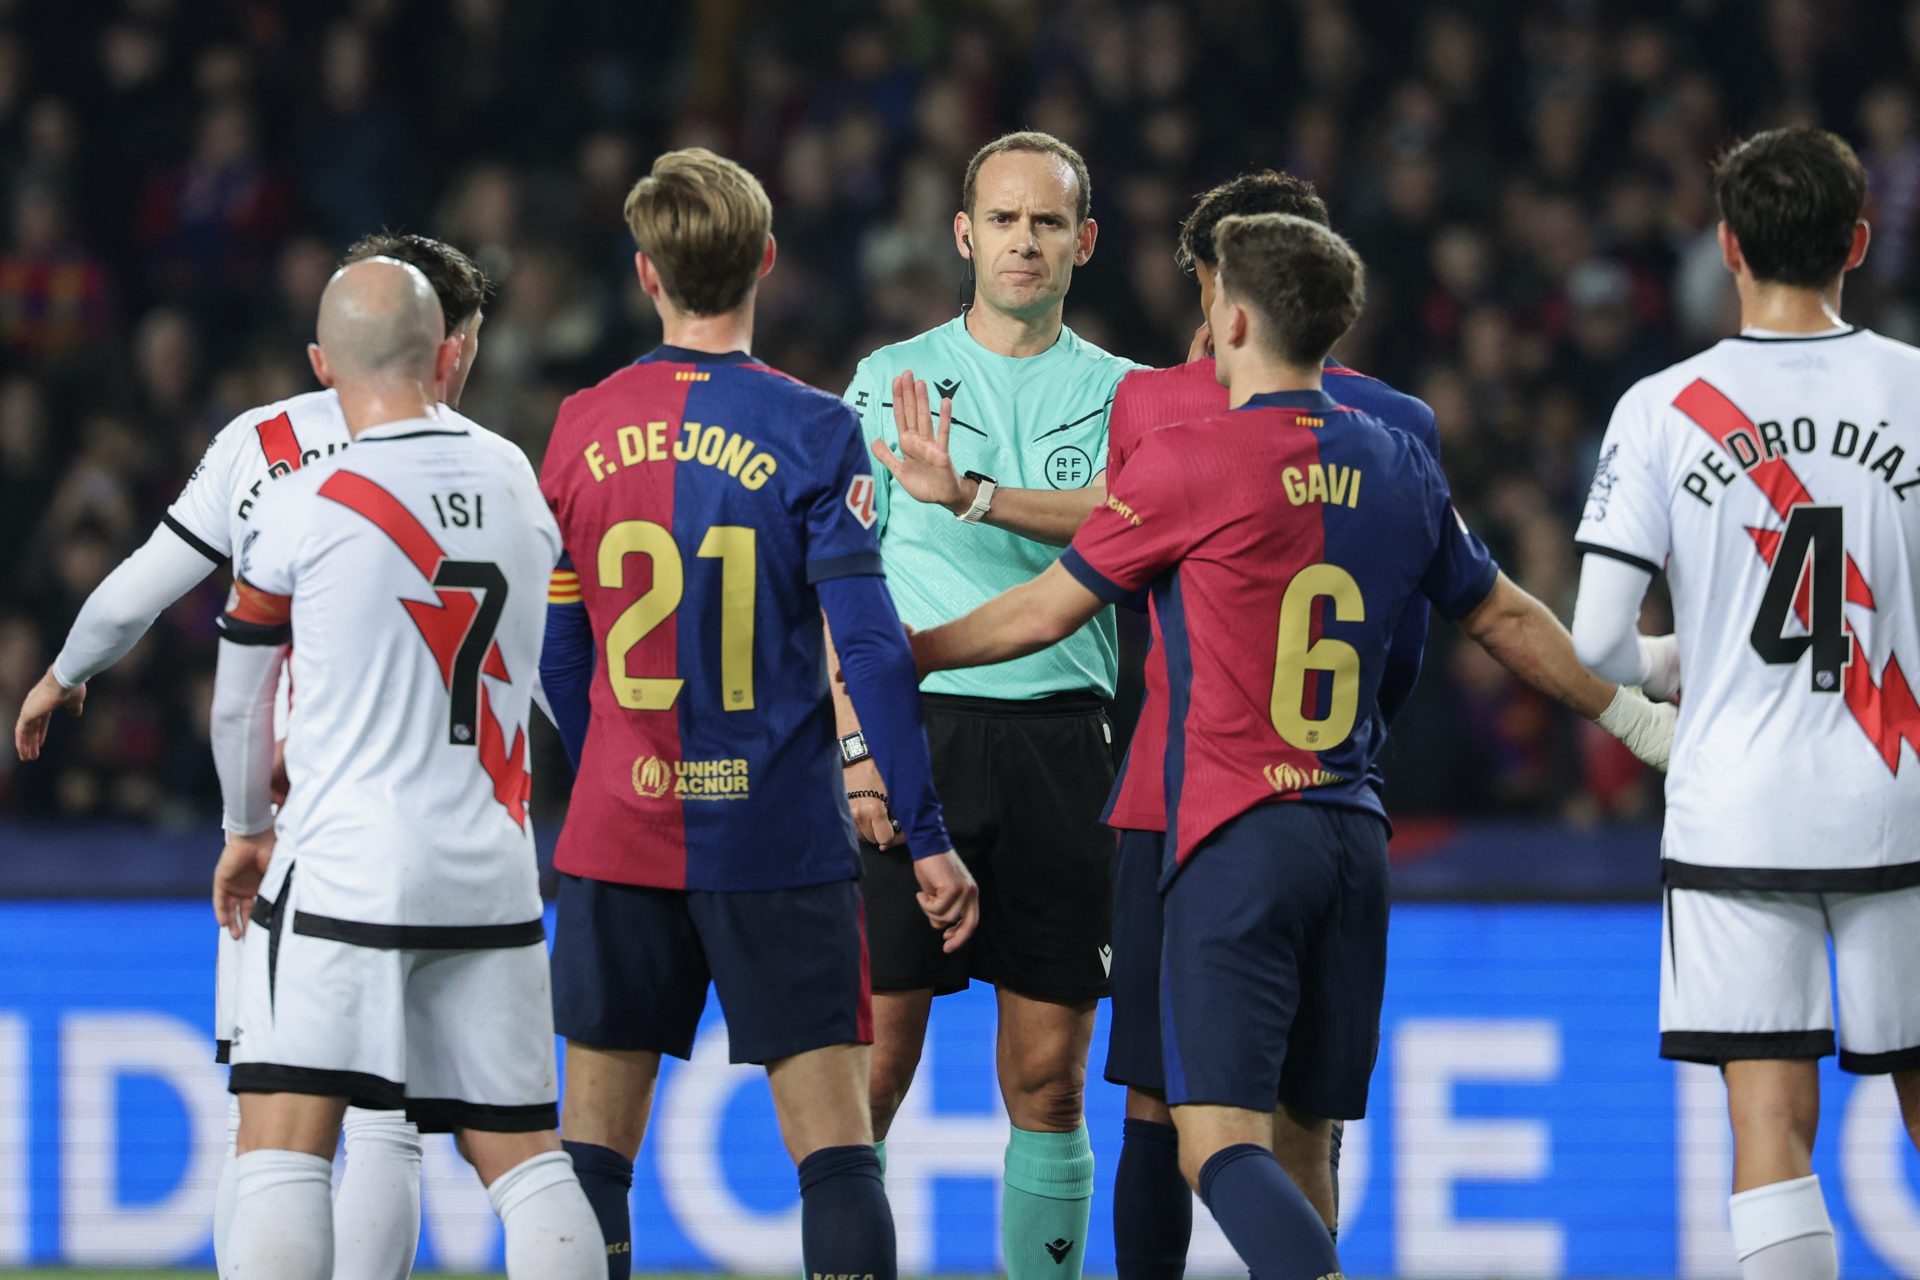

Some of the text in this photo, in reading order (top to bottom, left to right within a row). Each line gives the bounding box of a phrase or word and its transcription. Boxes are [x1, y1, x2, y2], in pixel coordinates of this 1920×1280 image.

[583, 421, 778, 491] F. DE JONG
[1281, 463, 1361, 509] GAVI
[1682, 417, 1817, 507] PEDRO
[432, 493, 483, 529] ISI
[597, 520, 757, 712] 21
[1750, 505, 1850, 692] 4
[432, 560, 508, 745] 7
[1270, 563, 1365, 752] 6
[673, 776, 749, 794] ACNUR
[674, 759, 748, 777] UNHCR
